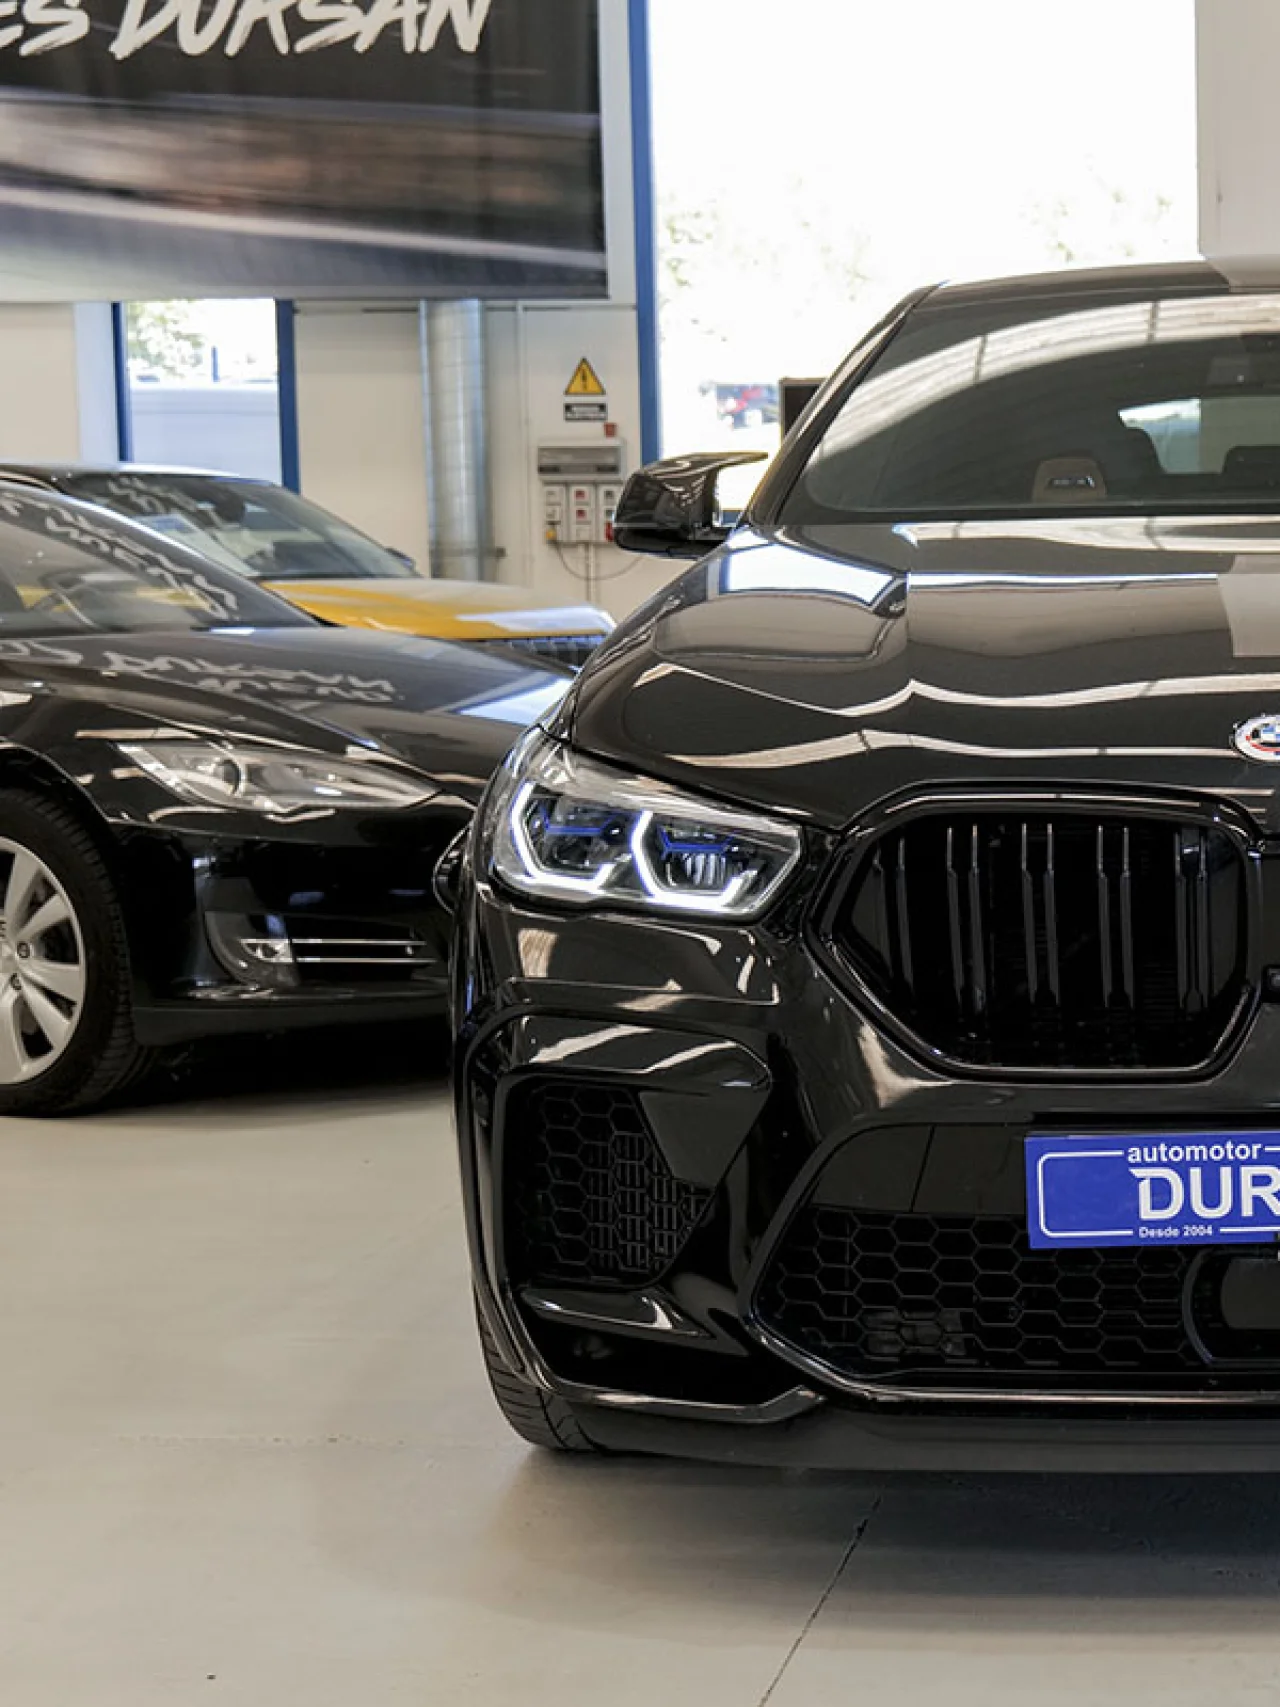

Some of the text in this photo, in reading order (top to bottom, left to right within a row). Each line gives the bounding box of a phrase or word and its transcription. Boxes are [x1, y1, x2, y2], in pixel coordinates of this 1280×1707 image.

[1128, 1140, 1262, 1162] automotor
[1139, 1224, 1213, 1239] Desde 2004
